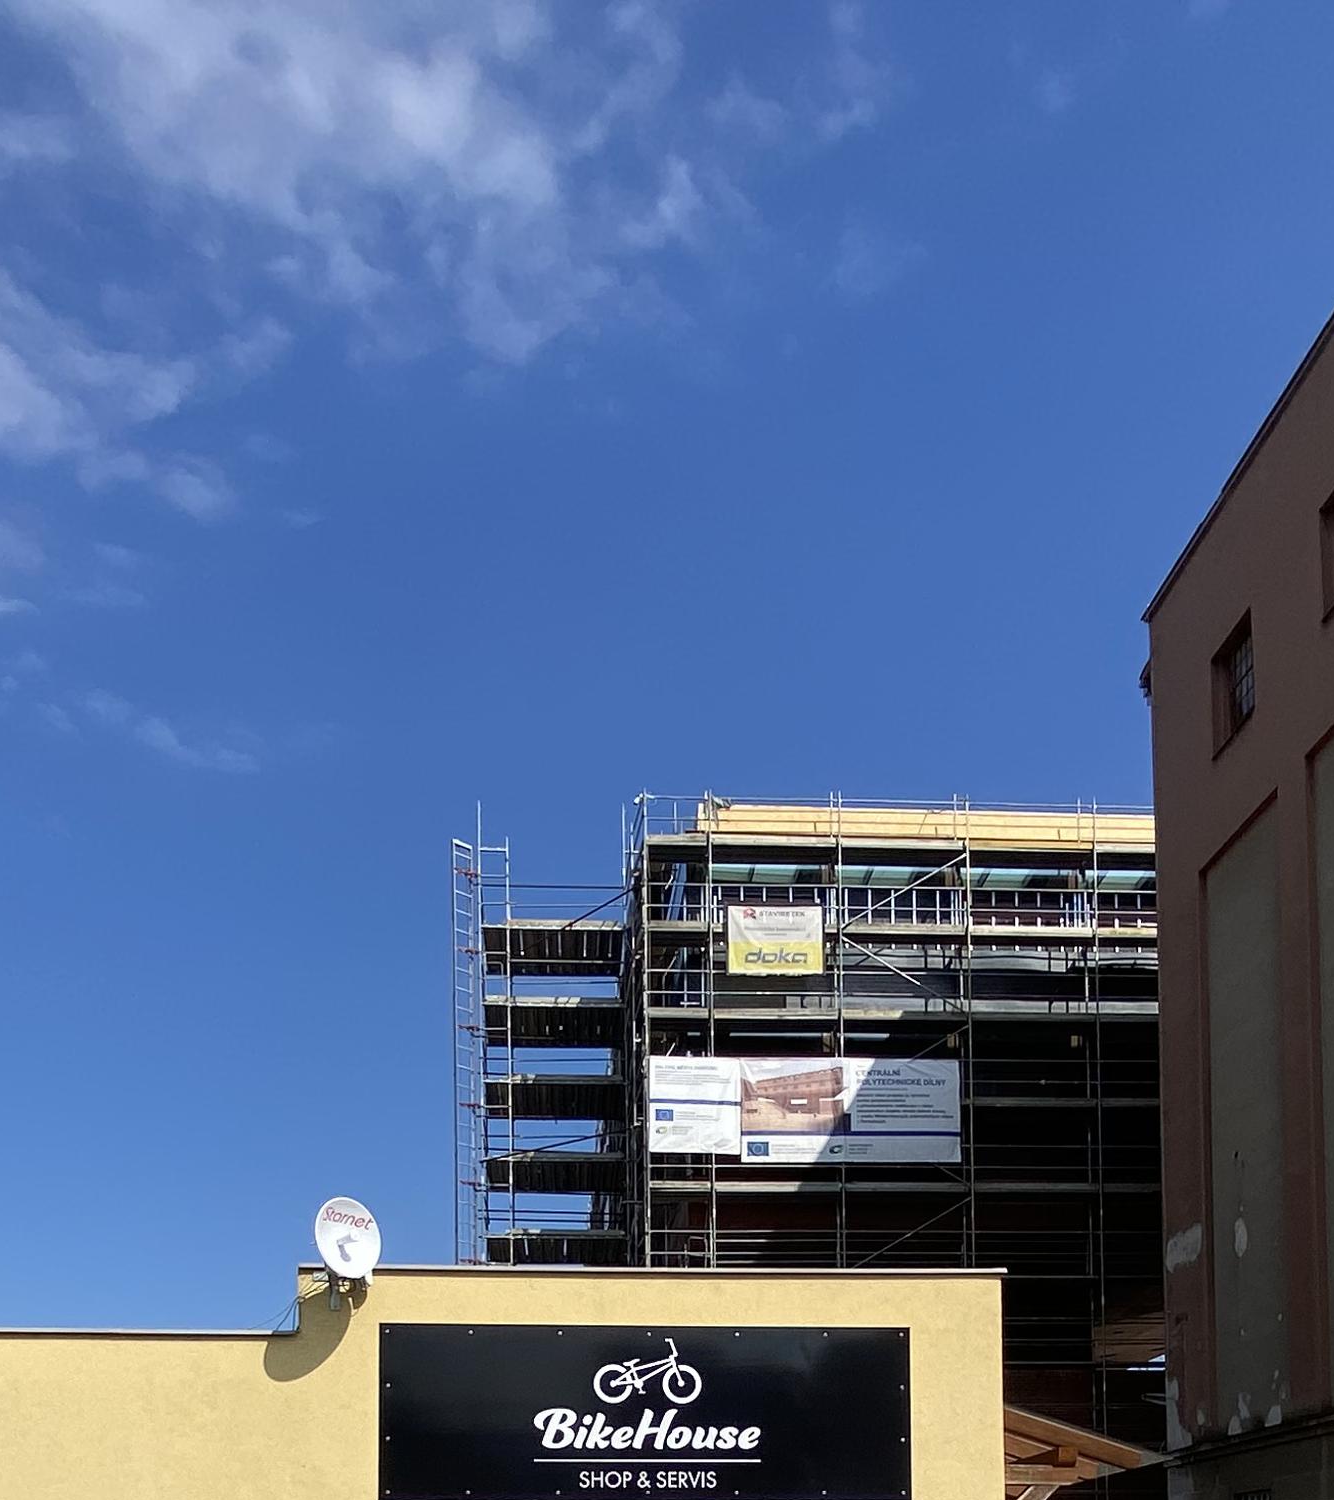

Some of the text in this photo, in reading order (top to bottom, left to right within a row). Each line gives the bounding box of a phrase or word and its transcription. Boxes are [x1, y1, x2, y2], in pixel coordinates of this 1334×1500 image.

[744, 947, 808, 964] doka
[533, 1407, 762, 1451] BikeHouse
[578, 1470, 718, 1489] SHOP & SERVIS
